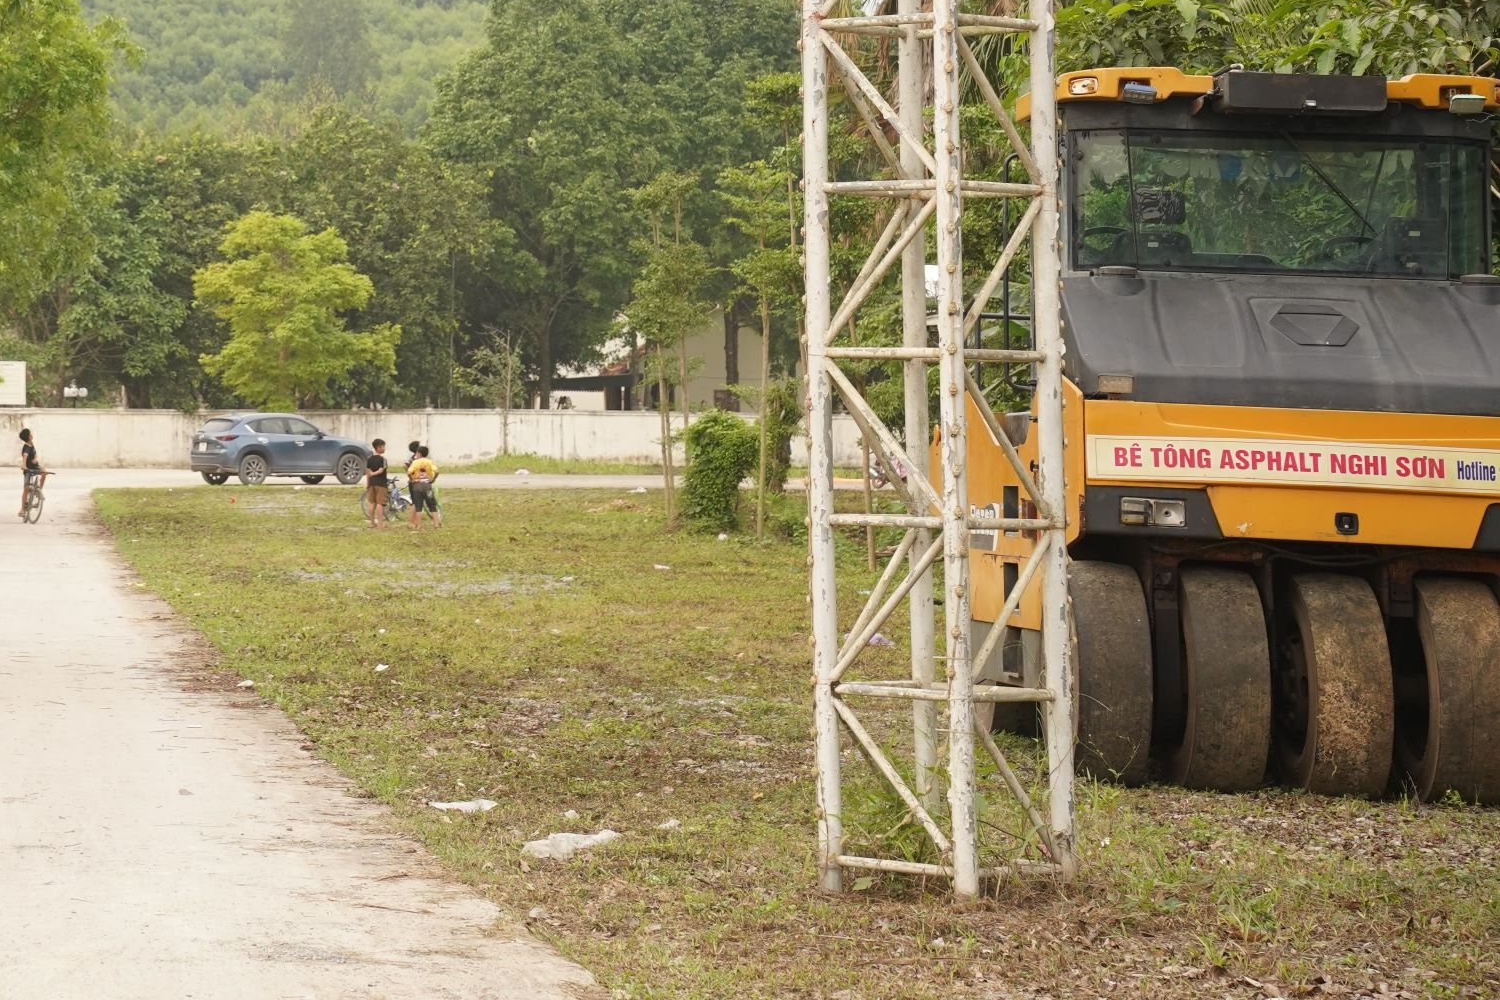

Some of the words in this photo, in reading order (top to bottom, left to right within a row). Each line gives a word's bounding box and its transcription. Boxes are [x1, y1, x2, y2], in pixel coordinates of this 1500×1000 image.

[1114, 442, 1143, 468] BÊ
[1150, 443, 1212, 469] TÔNG
[1219, 449, 1322, 473] ASPHALT
[1330, 453, 1388, 477] NGHI
[1395, 455, 1445, 479] SƠN
[1456, 460, 1496, 482] Hotline
